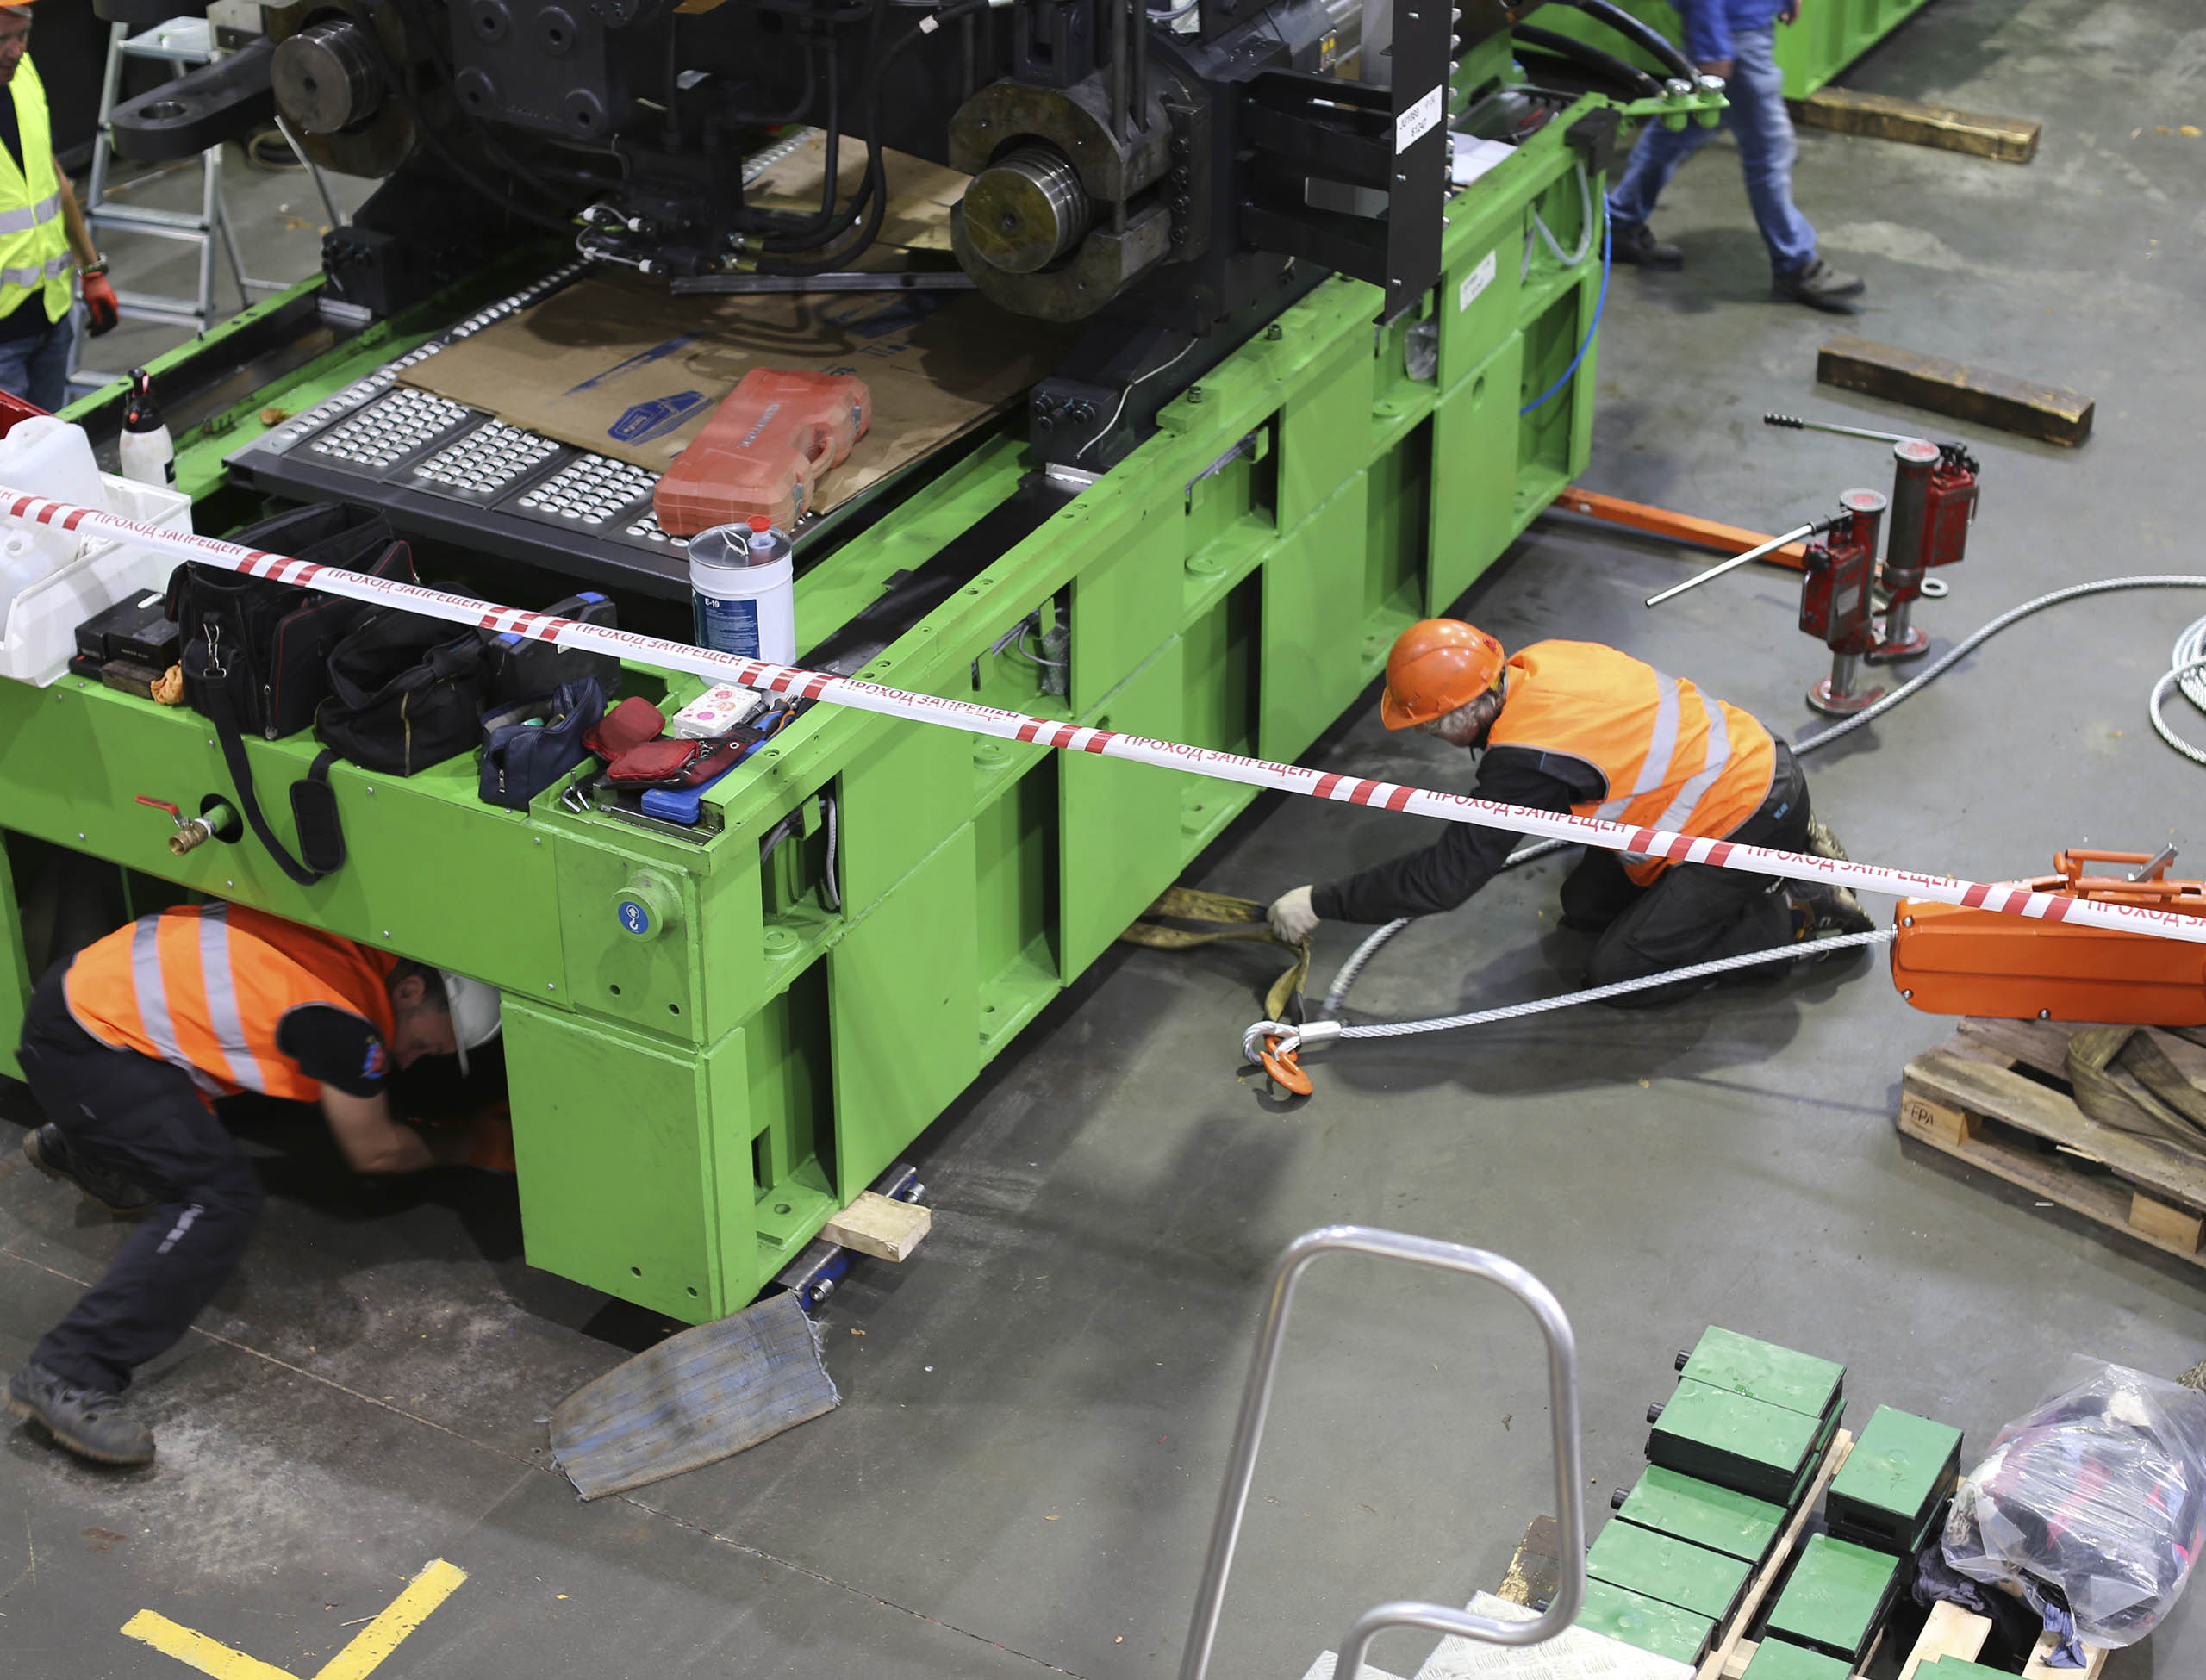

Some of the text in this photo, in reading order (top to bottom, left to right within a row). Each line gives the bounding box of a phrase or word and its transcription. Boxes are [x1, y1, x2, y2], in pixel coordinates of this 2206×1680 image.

[94, 511, 243, 556] ПРОХОД ЗАПРЕЩЕН
[327, 569, 485, 609] ПРОХОД ЗАПРЕЩЕН
[705, 597, 720, 608] E-19
[575, 623, 743, 667] ПРОХОД ЗАПРЕЩЕН
[839, 678, 1019, 723] ПРОХОД ЗАПРЕЩЕН
[1124, 734, 1313, 777] ПРОХОД ЗАПРЕЩЕН
[1426, 789, 1626, 833] ПРОХОД ЗАПРЕЩЕН
